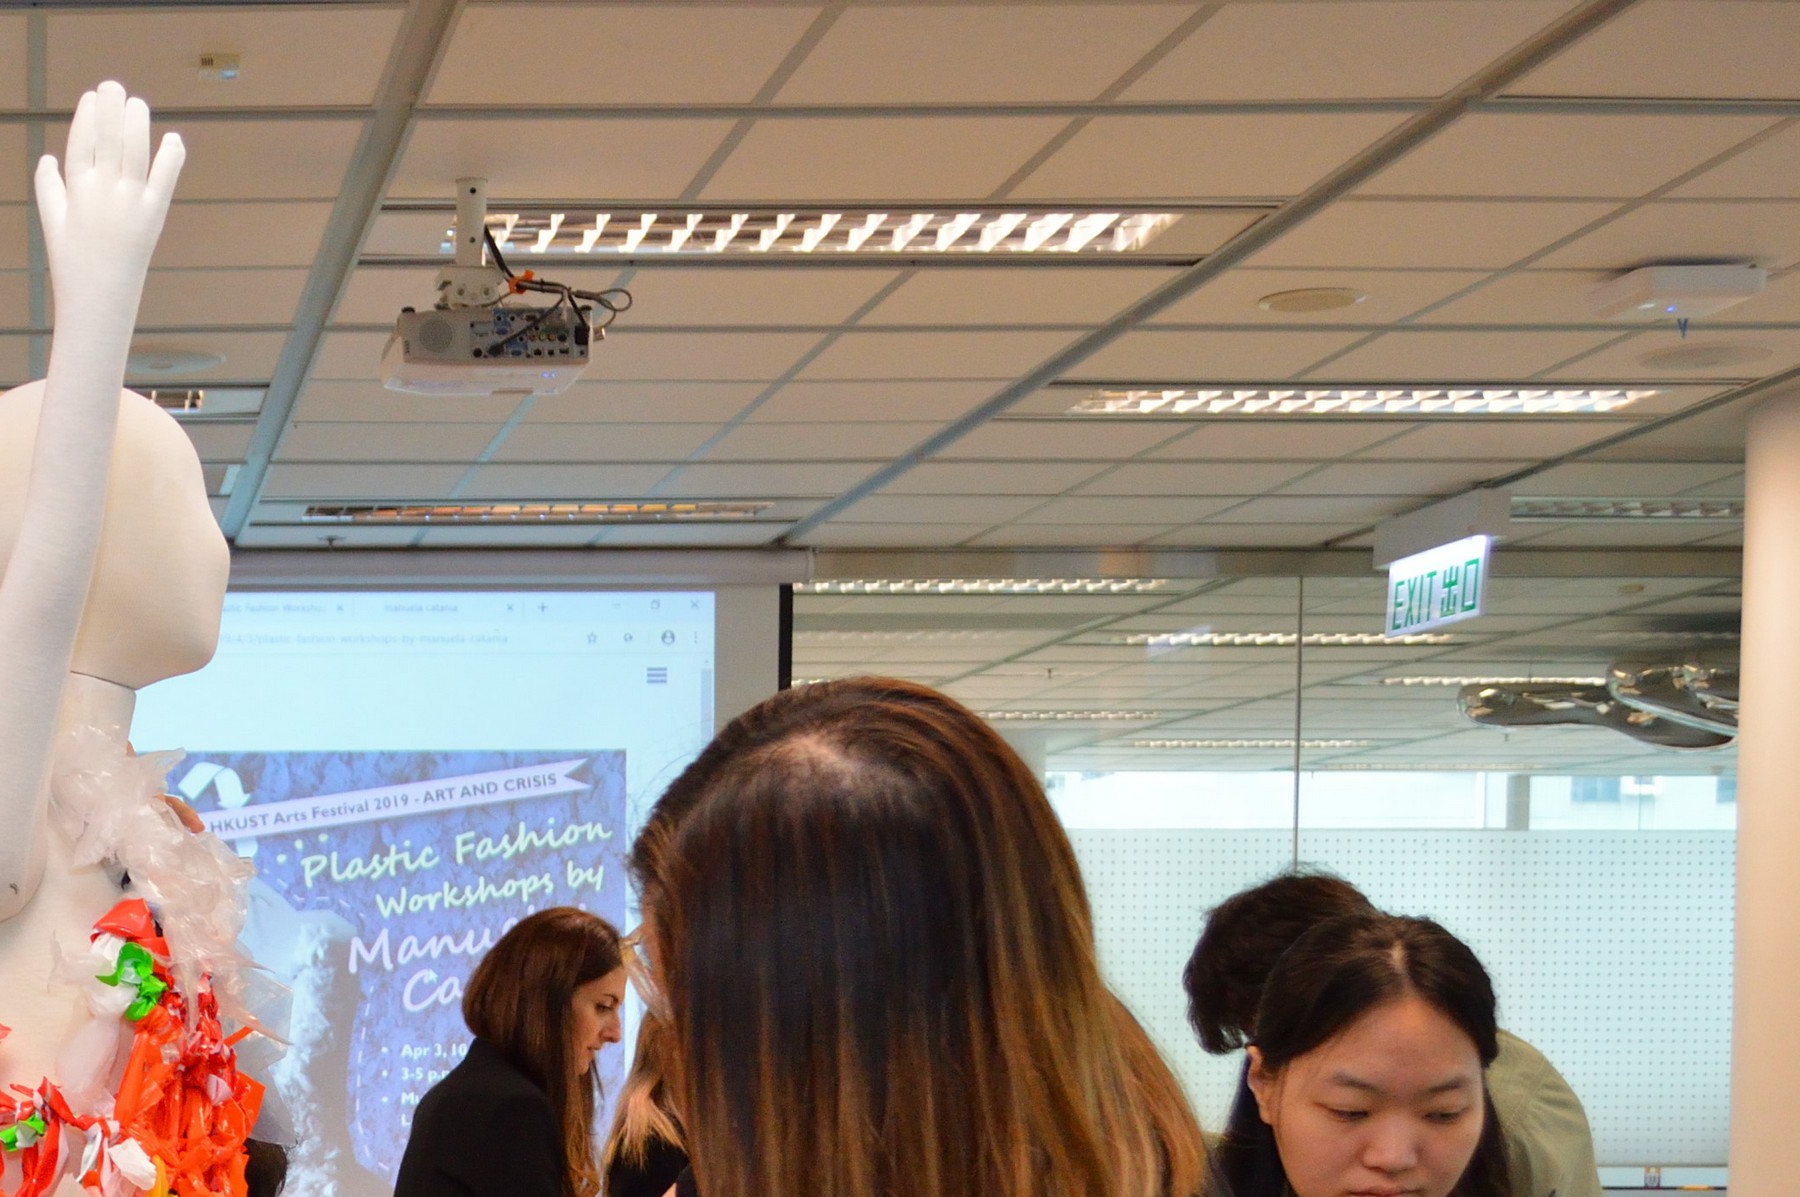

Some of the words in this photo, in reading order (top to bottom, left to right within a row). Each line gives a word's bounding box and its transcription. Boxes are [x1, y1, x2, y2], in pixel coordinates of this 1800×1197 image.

[1392, 570, 1437, 631] EXIT
[1440, 558, 1480, 619] 出口
[210, 812, 270, 833] HKUST
[273, 810, 308, 825] Arts
[312, 801, 369, 819] Festival
[375, 793, 409, 811] 2019
[423, 786, 456, 804] ART
[460, 781, 498, 799] AND
[503, 772, 558, 792] CRISIS
[300, 840, 440, 888] Plastic
[453, 816, 612, 867] Fashion
[375, 869, 556, 919] Workshops
[566, 859, 606, 893] by
[349, 904, 535, 974] Manu
[401, 1043, 430, 1060] Apr
[401, 1066, 424, 1080] 3-5
